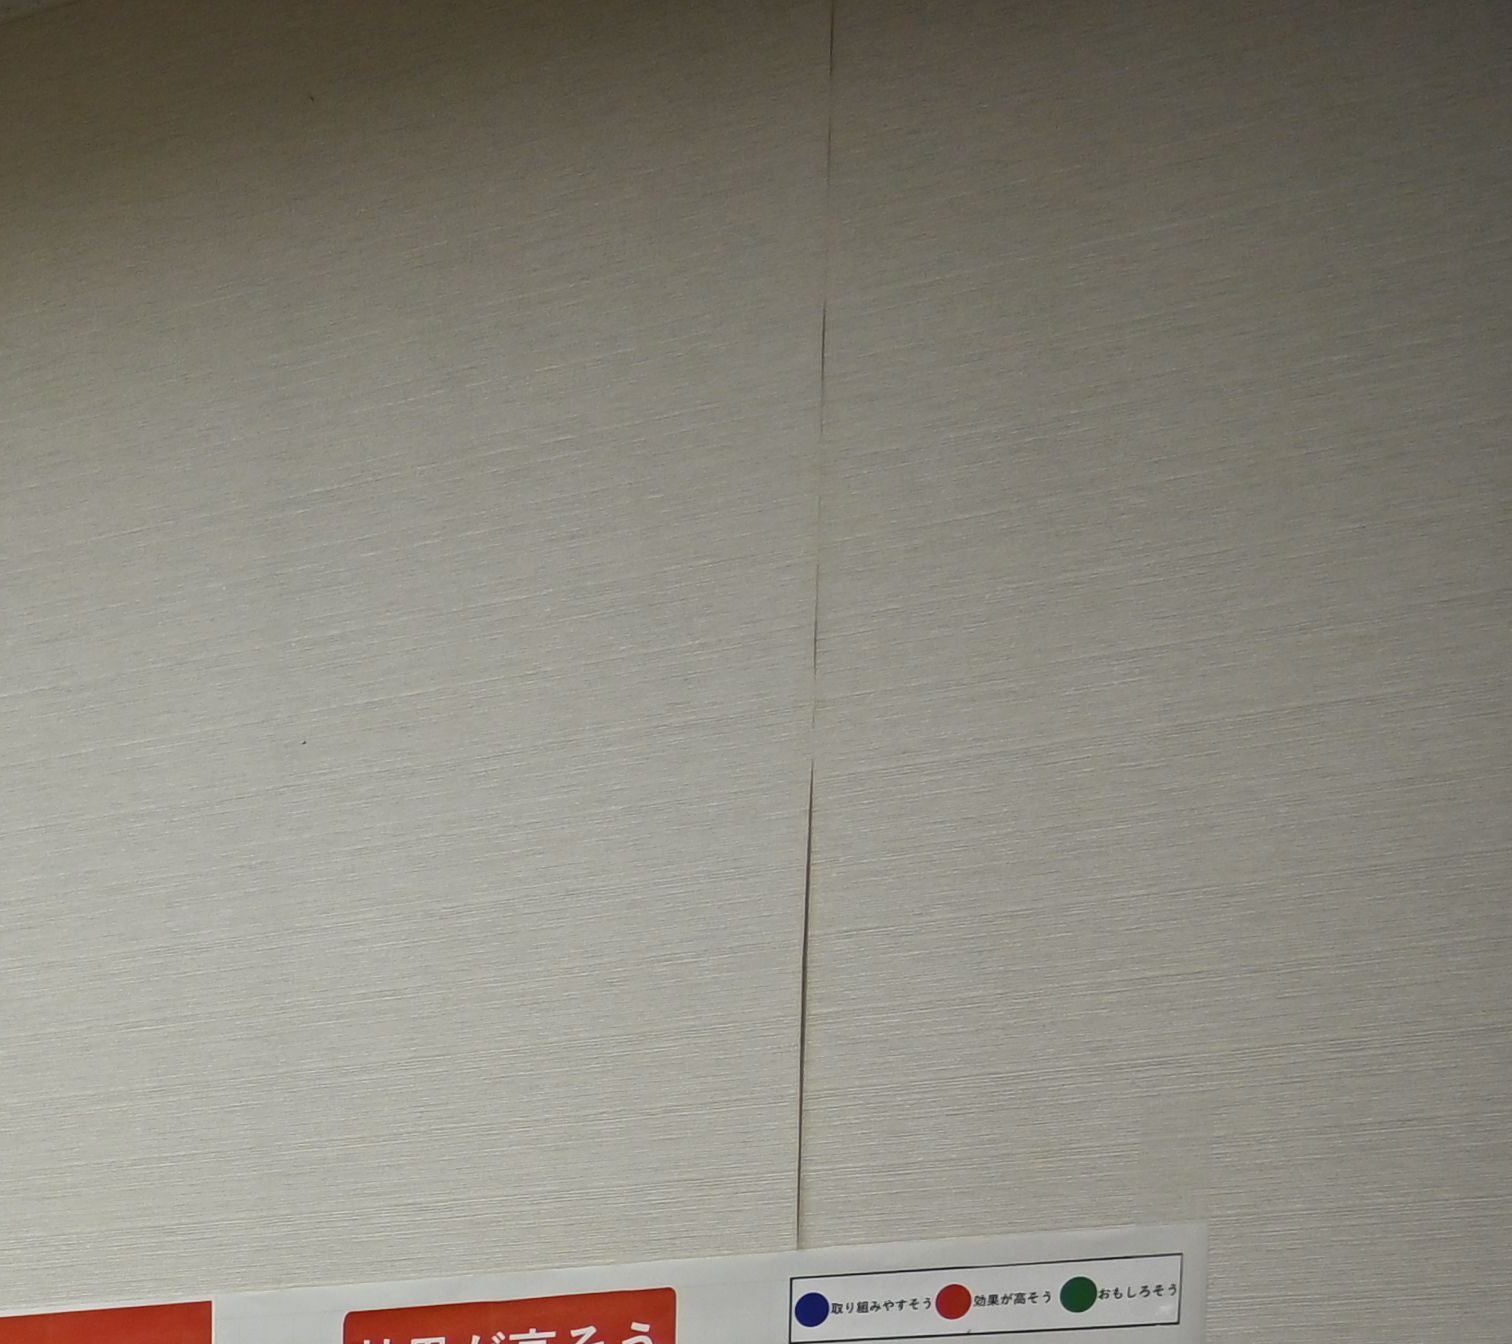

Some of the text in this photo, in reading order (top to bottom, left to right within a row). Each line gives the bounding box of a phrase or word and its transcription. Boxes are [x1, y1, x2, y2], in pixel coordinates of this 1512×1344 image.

[973, 1290, 1053, 1308] 効果が高そう
[1097, 1283, 1178, 1301] おもしろそう
[831, 1297, 934, 1316] 取り組みやすそう
